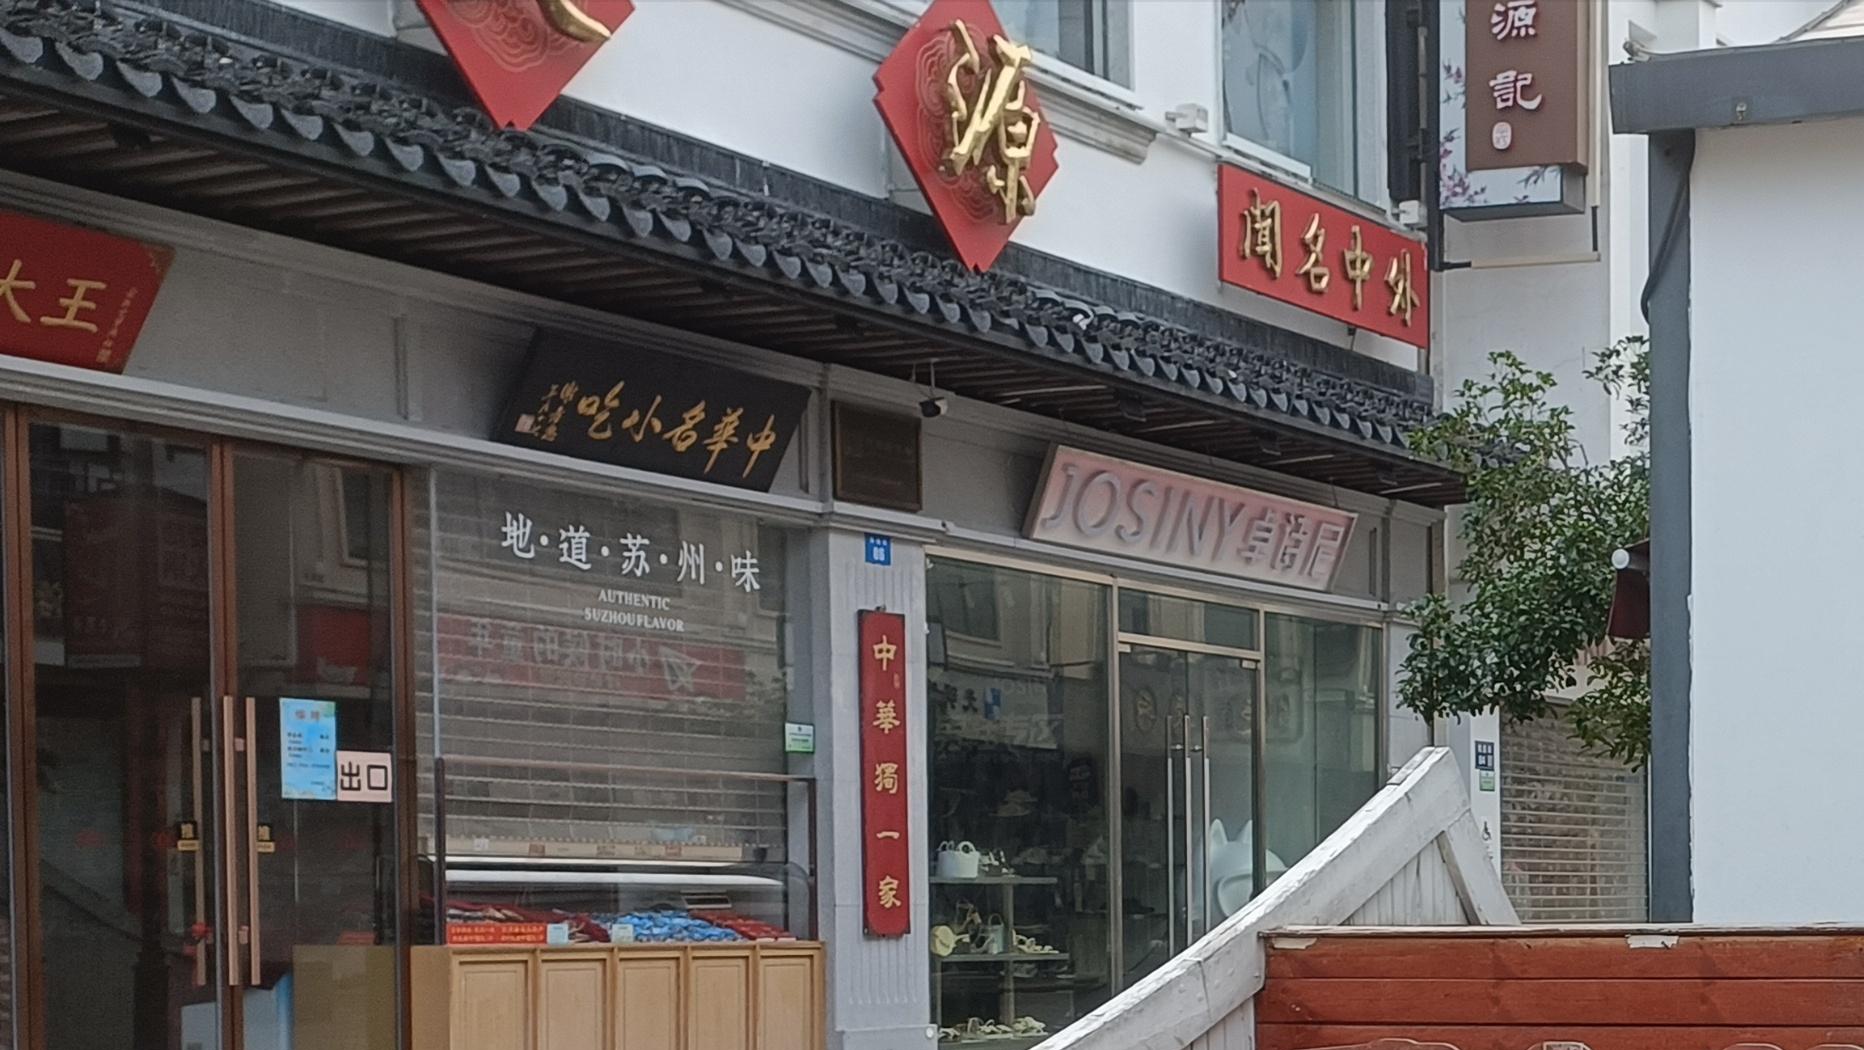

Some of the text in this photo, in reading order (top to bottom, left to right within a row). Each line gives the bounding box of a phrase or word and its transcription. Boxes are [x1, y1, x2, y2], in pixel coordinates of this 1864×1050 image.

[1040, 462, 1246, 562] JOSINY
[598, 589, 671, 610] AUTHENTIC
[341, 761, 388, 791] 出口
[872, 634, 902, 909] 中華獨一家
